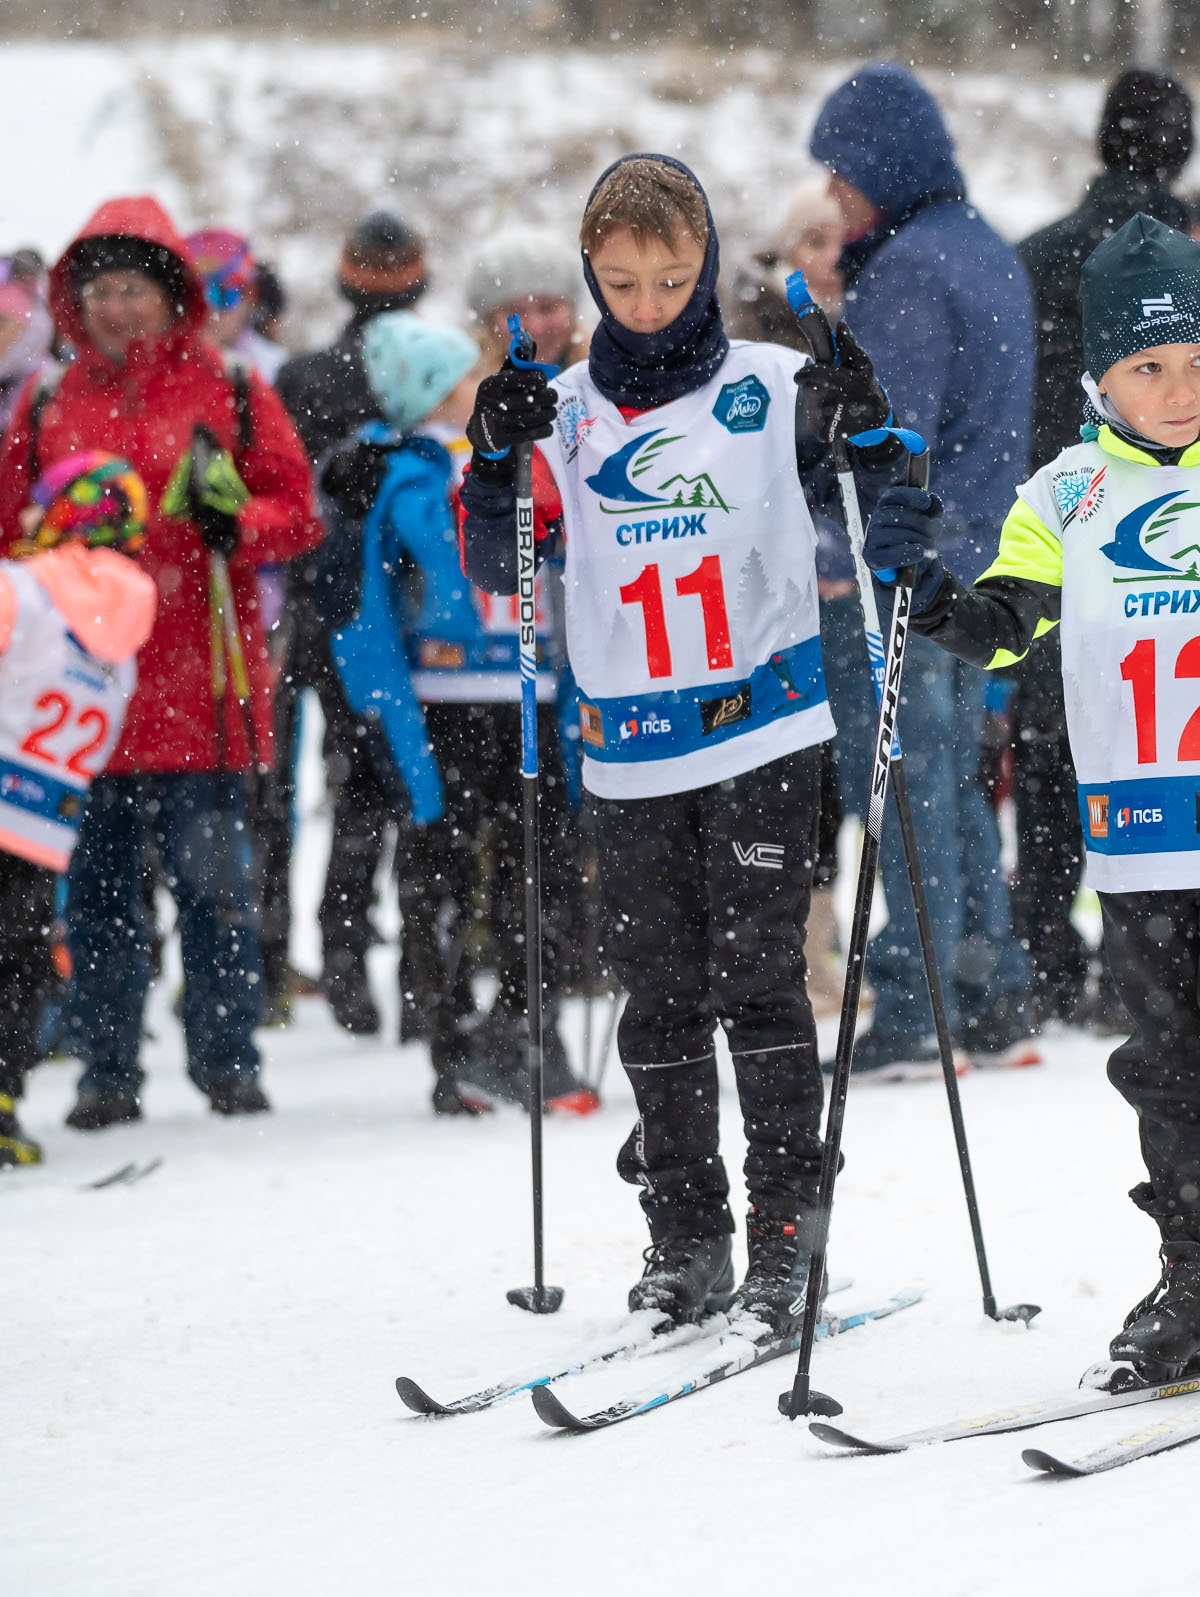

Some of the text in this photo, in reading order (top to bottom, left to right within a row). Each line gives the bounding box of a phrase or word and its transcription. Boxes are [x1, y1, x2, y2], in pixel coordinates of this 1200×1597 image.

[1132, 312, 1194, 333] NORDSKI
[616, 513, 707, 546] СТРИЖ
[518, 505, 534, 646] BRADOS
[619, 554, 734, 680] 11
[873, 588, 909, 799] ADSHUS
[20, 691, 107, 780] 22
[641, 718, 672, 735] ПСБ
[1132, 808, 1164, 824] ПСБ
